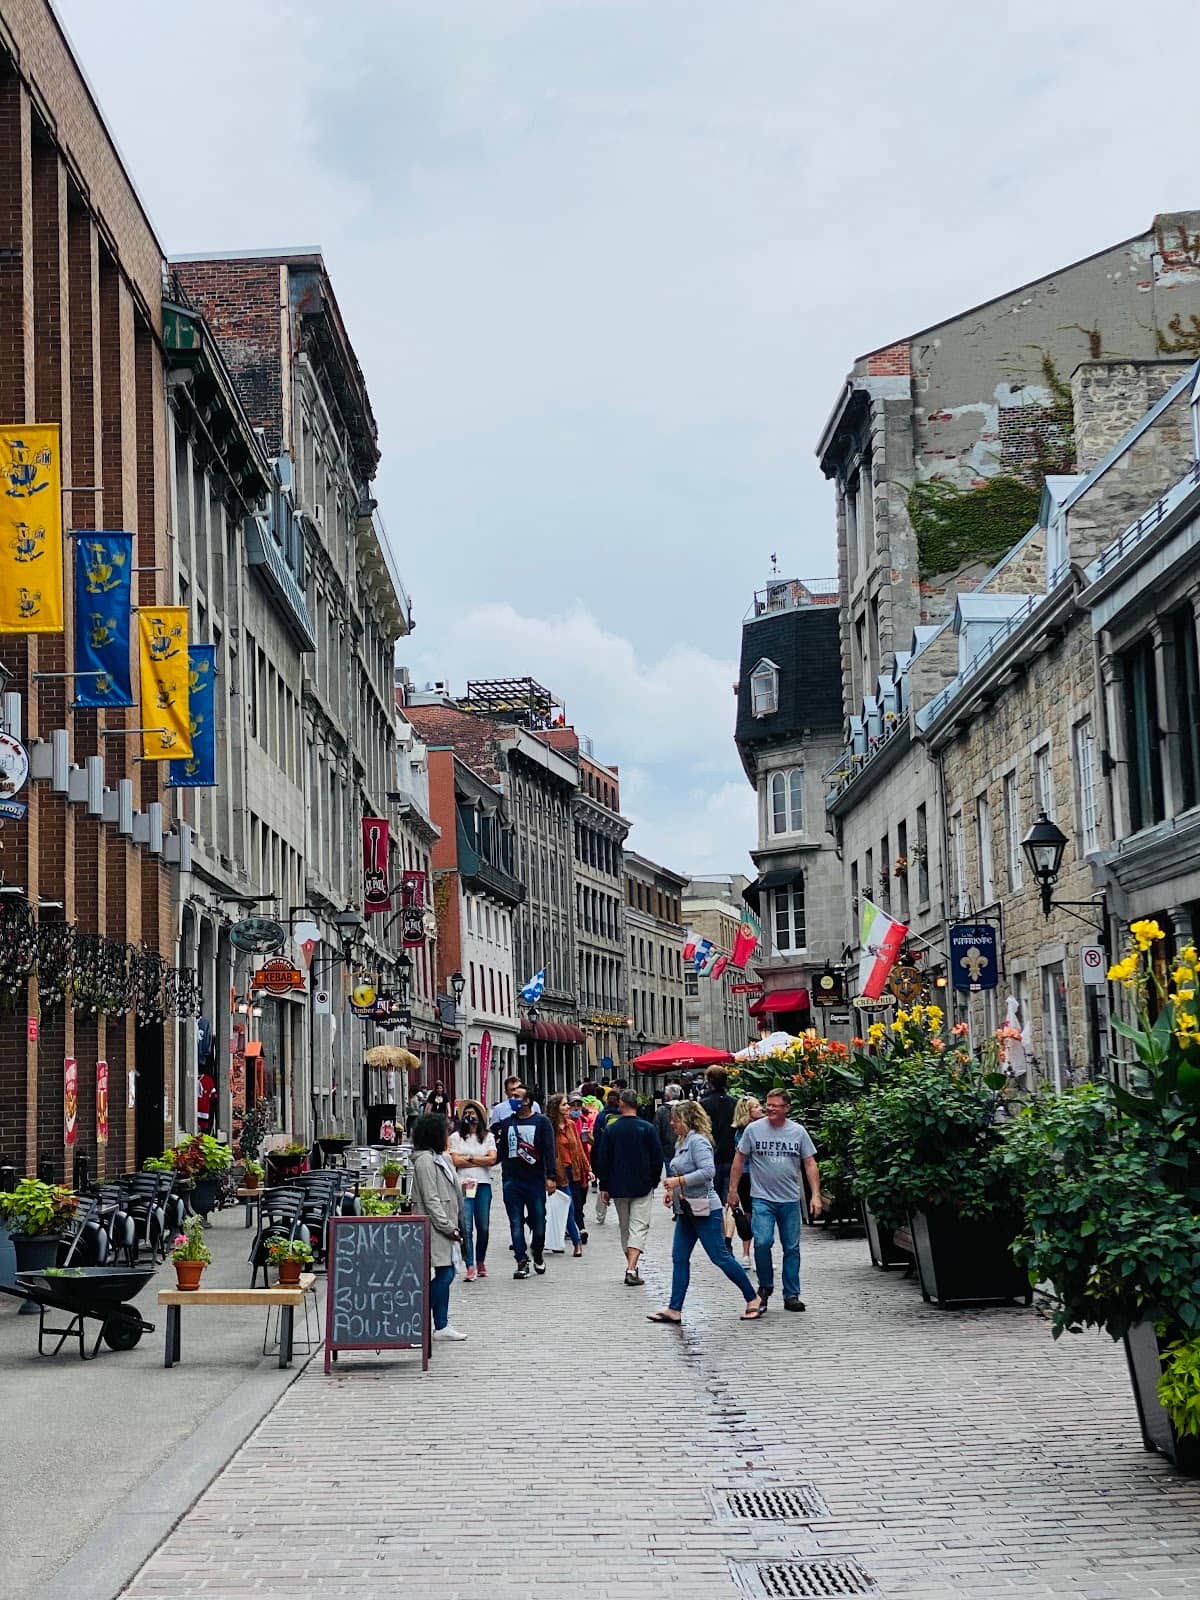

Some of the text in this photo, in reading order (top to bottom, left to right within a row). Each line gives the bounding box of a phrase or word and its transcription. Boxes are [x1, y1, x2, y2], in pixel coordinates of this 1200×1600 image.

[263, 959, 293, 970] MONTREAL
[264, 972, 292, 982] KEBAB
[755, 1140, 800, 1152] BUFFALO
[335, 1286, 423, 1315] Burger
